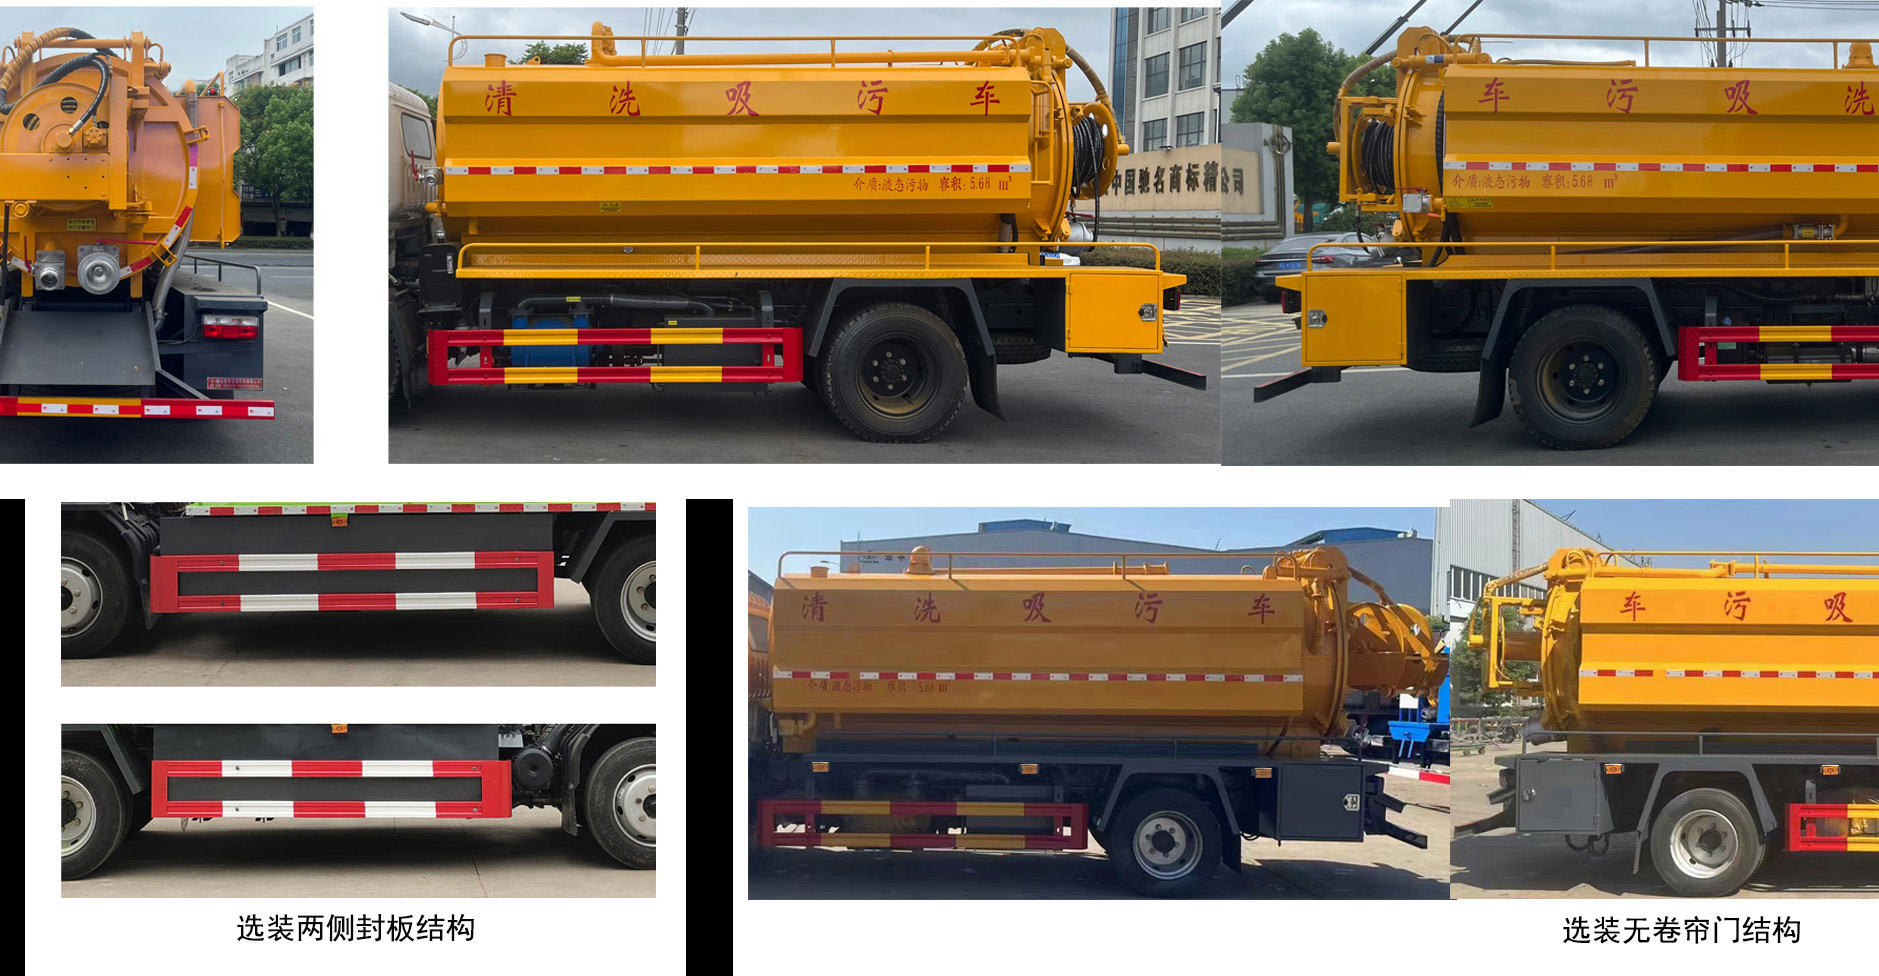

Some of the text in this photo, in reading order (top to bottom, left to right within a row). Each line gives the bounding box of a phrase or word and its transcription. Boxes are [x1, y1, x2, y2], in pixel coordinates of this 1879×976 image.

[1105, 160, 1219, 197] 中国驰名商标精
